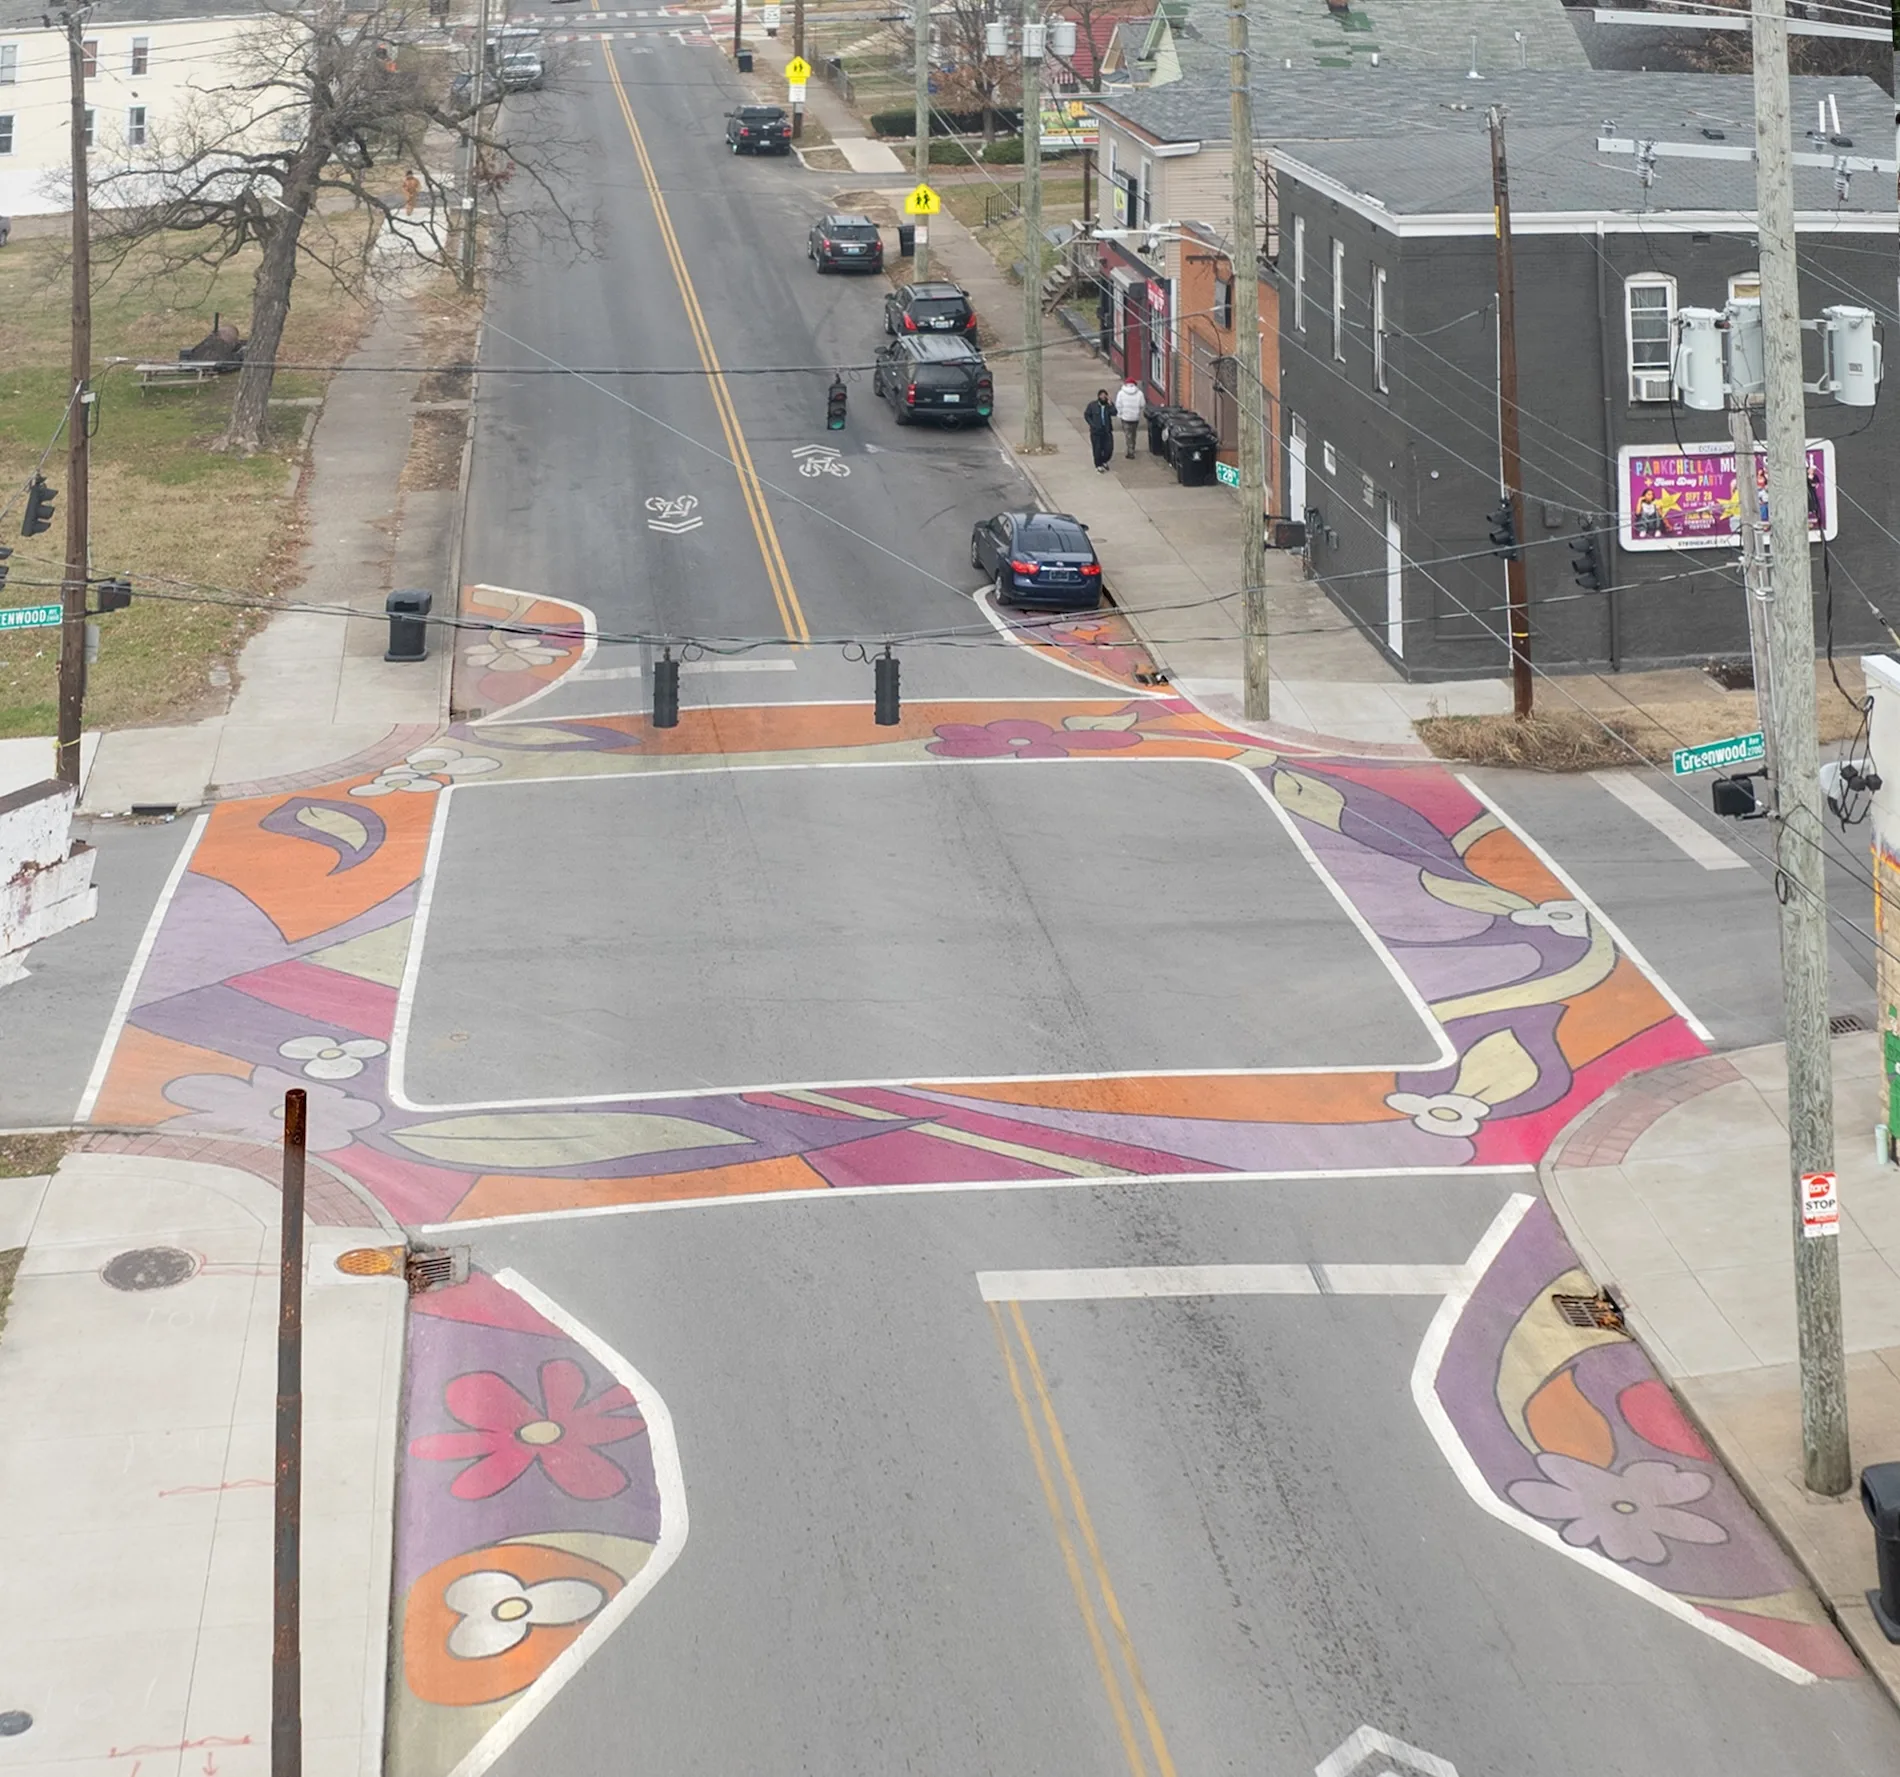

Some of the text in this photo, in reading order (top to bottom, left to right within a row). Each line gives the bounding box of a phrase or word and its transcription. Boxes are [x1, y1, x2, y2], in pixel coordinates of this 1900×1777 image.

[1635, 458, 1714, 476] PARKCHELLA
[1698, 474, 1724, 486] PARTY
[0, 609, 46, 626] ENWOOD
[1681, 740, 1747, 770] Greenwood
[1805, 1199, 1836, 1210] STOP
